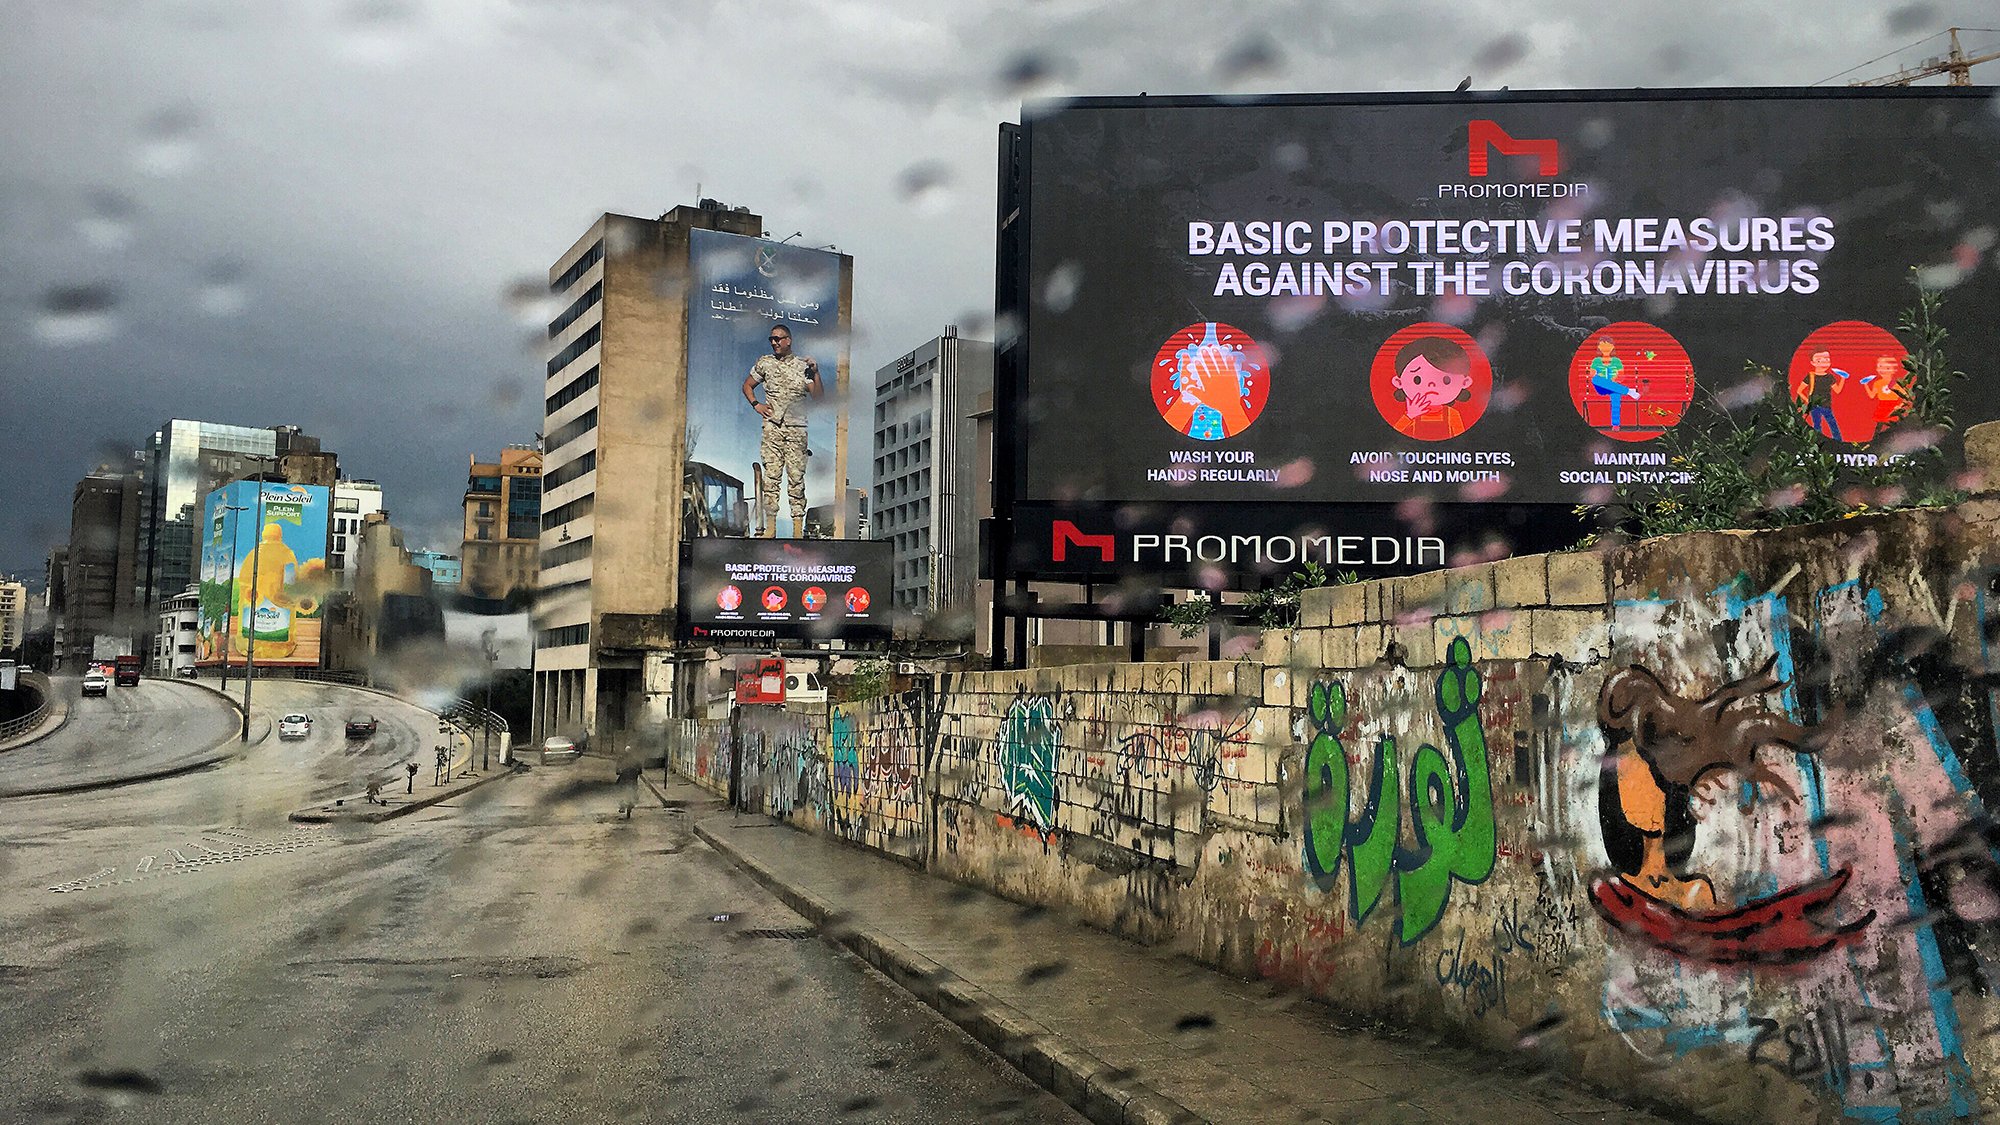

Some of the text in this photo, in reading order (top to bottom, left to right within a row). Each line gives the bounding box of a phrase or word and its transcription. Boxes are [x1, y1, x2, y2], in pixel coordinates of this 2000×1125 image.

[1438, 183, 1589, 198] PROMOMEDIA
[1188, 217, 1836, 256] BASIC PROTECTIVE MEASURES
[1213, 259, 1820, 297] AGAINST THE CORONAVIRUS
[711, 300, 754, 313] لطانا
[1169, 451, 1255, 463] WASH YOUR
[1350, 452, 1516, 467] AVOID TOUCHING EYES,
[1593, 452, 1667, 465] MAINTAIN
[1147, 469, 1280, 482] HANDS REGULARLY
[1370, 470, 1500, 483] NOSE AND MOUTH
[1559, 471, 1706, 484] SOCIAL DISTANCIN
[260, 491, 313, 504] Plein Soleil
[266, 509, 301, 518] SUPPORT
[1133, 533, 1446, 565] PROMOMEDIA
[725, 563, 857, 574] BASIC PROTECTIVE MEASURES
[730, 572, 854, 583] AGAINST THE CORONAVIRUS
[710, 628, 776, 637] PROMOMEDIA
[1303, 635, 1496, 947] ثورة
